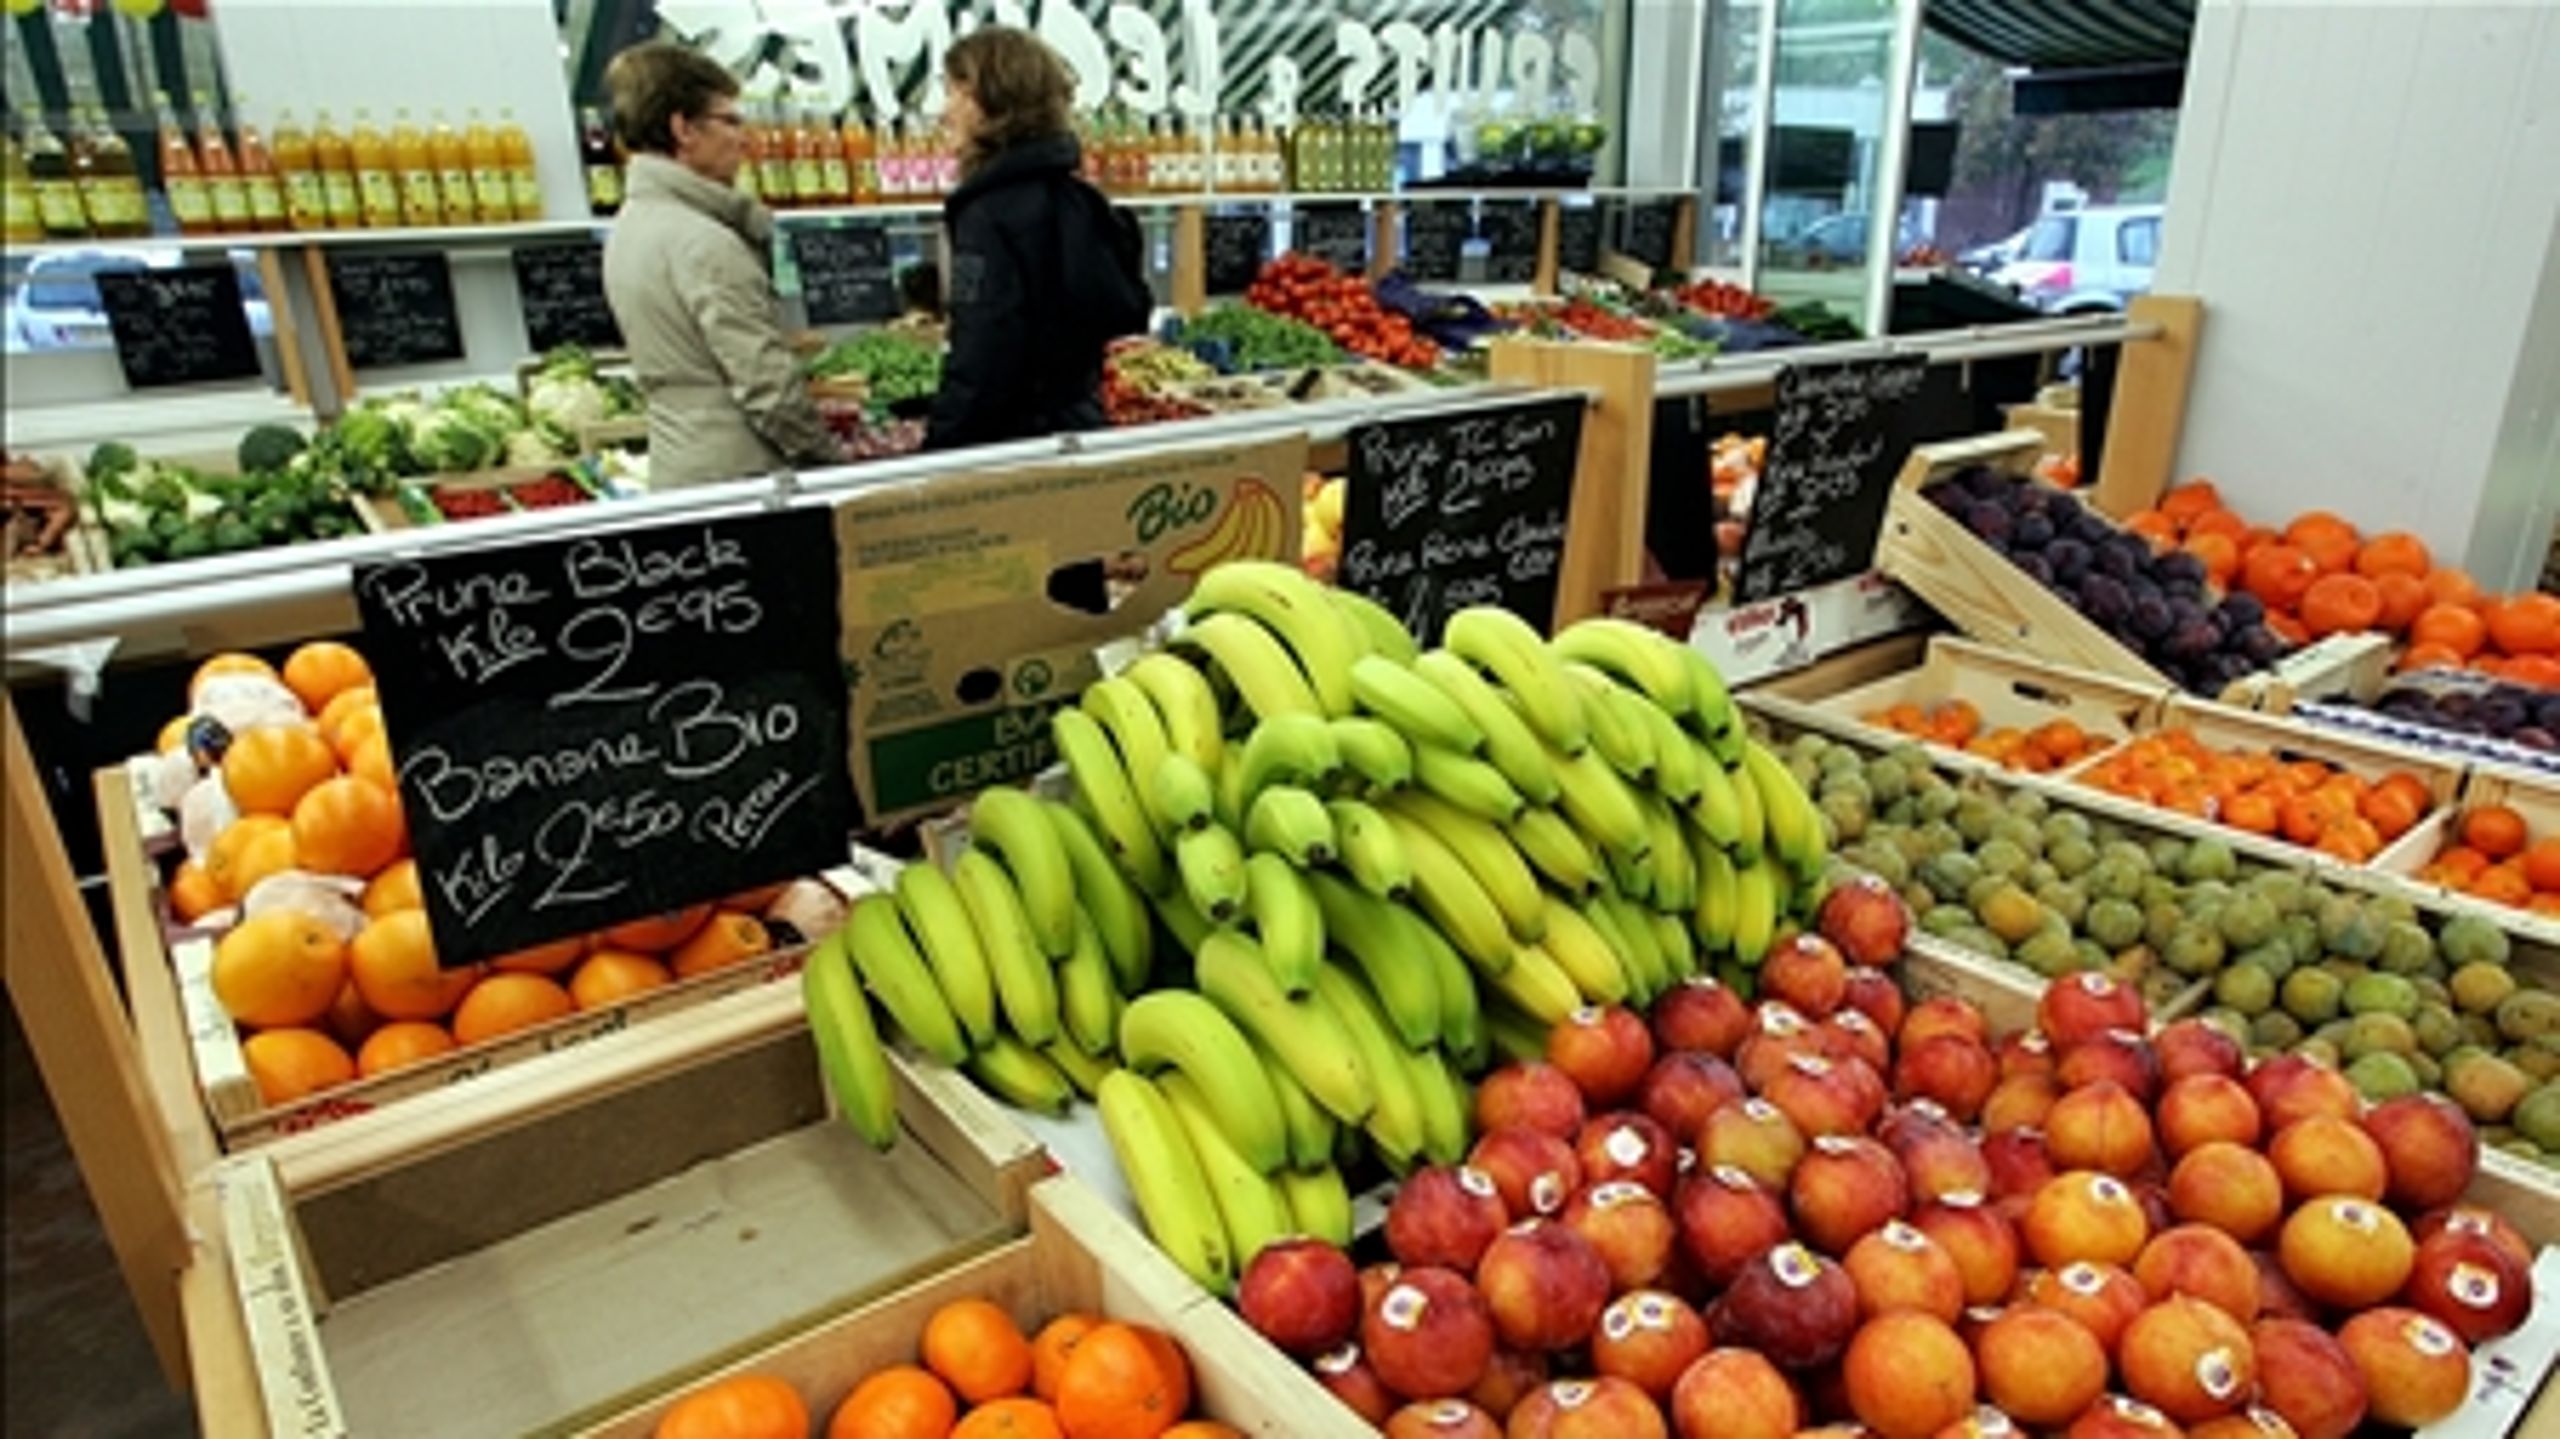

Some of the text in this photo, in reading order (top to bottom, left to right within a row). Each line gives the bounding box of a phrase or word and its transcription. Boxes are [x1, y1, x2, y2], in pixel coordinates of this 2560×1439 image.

[1126, 481, 1220, 544] Bio
[362, 526, 750, 627] Prune Black
[400, 745, 661, 822] Banane
[927, 738, 1052, 794] CERTIF
